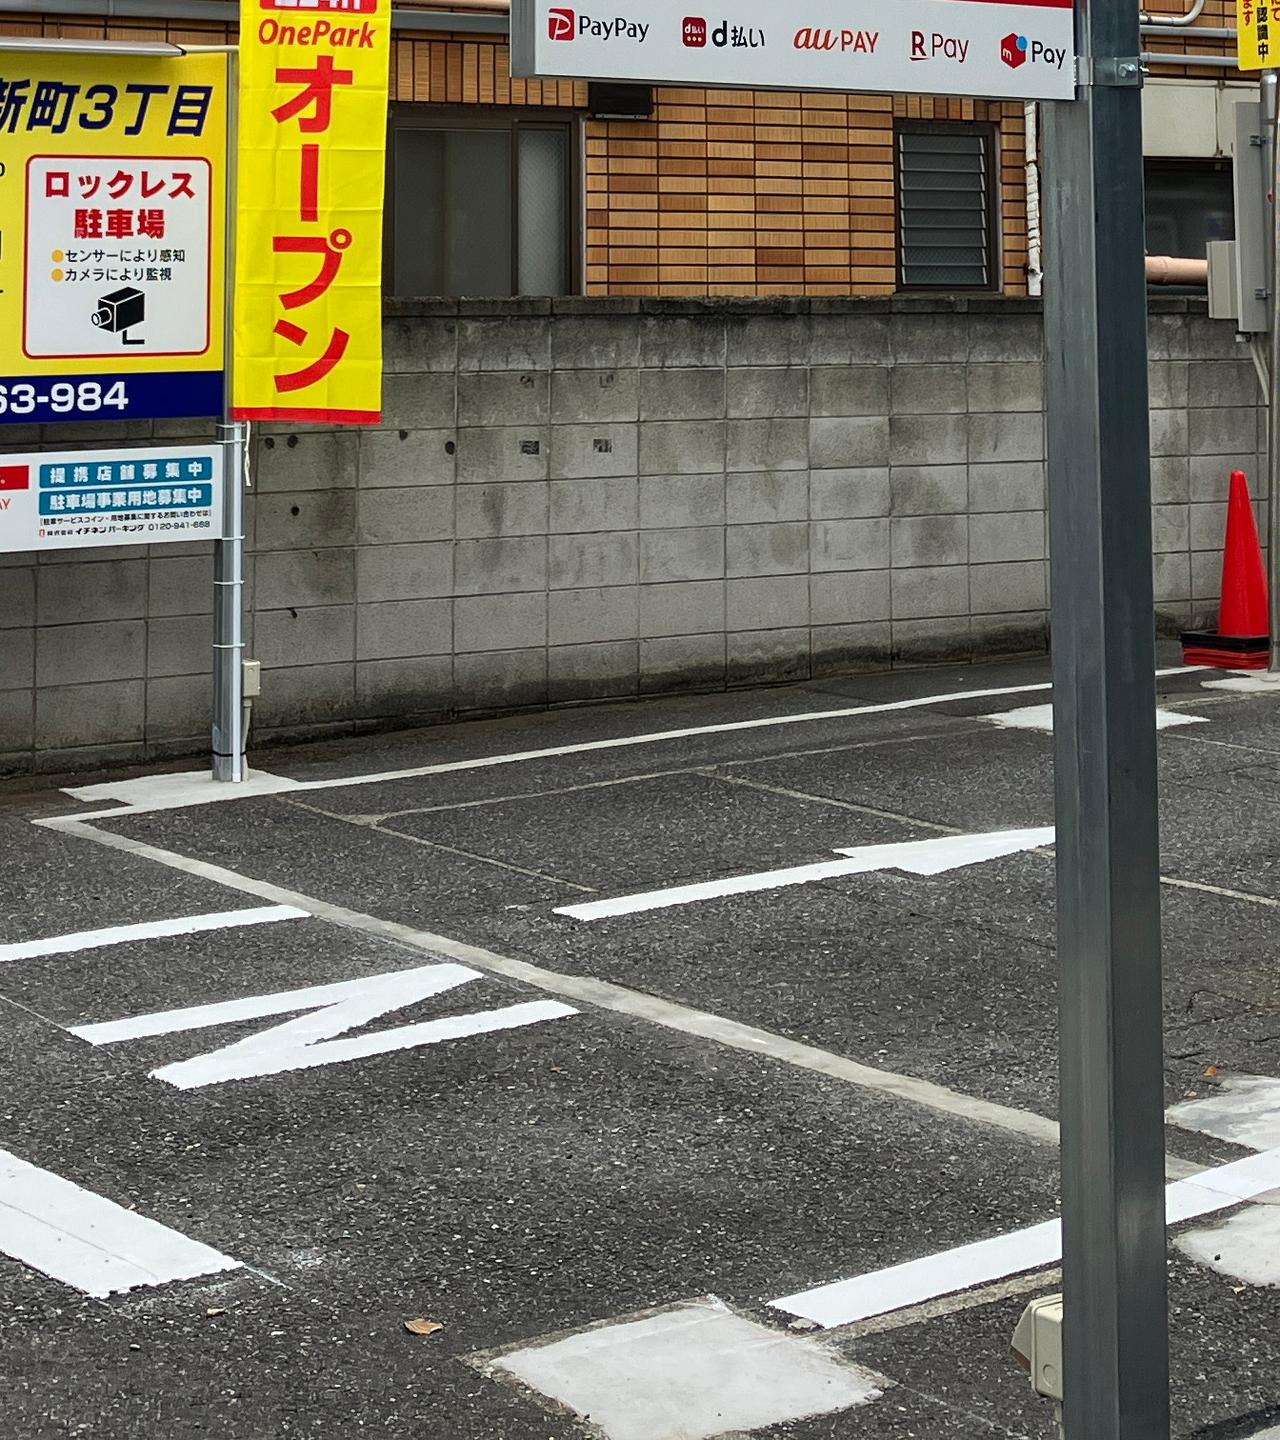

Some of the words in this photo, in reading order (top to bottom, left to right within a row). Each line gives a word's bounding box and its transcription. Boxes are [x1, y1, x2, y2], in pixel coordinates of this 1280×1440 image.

[258, 18, 376, 49] OnePark
[578, 15, 650, 43] PayPay
[711, 20, 766, 48] d払い
[792, 27, 839, 51] au
[840, 30, 880, 54] PAY
[931, 33, 970, 63] Pay
[1031, 40, 1067, 70] Pay
[44, 170, 196, 200] ロックレス
[73, 208, 166, 240] 駐車場
[270, 55, 354, 393] オープン
[65, 249, 186, 263] センサーにより感知
[65, 267, 172, 281] カメラにより監視
